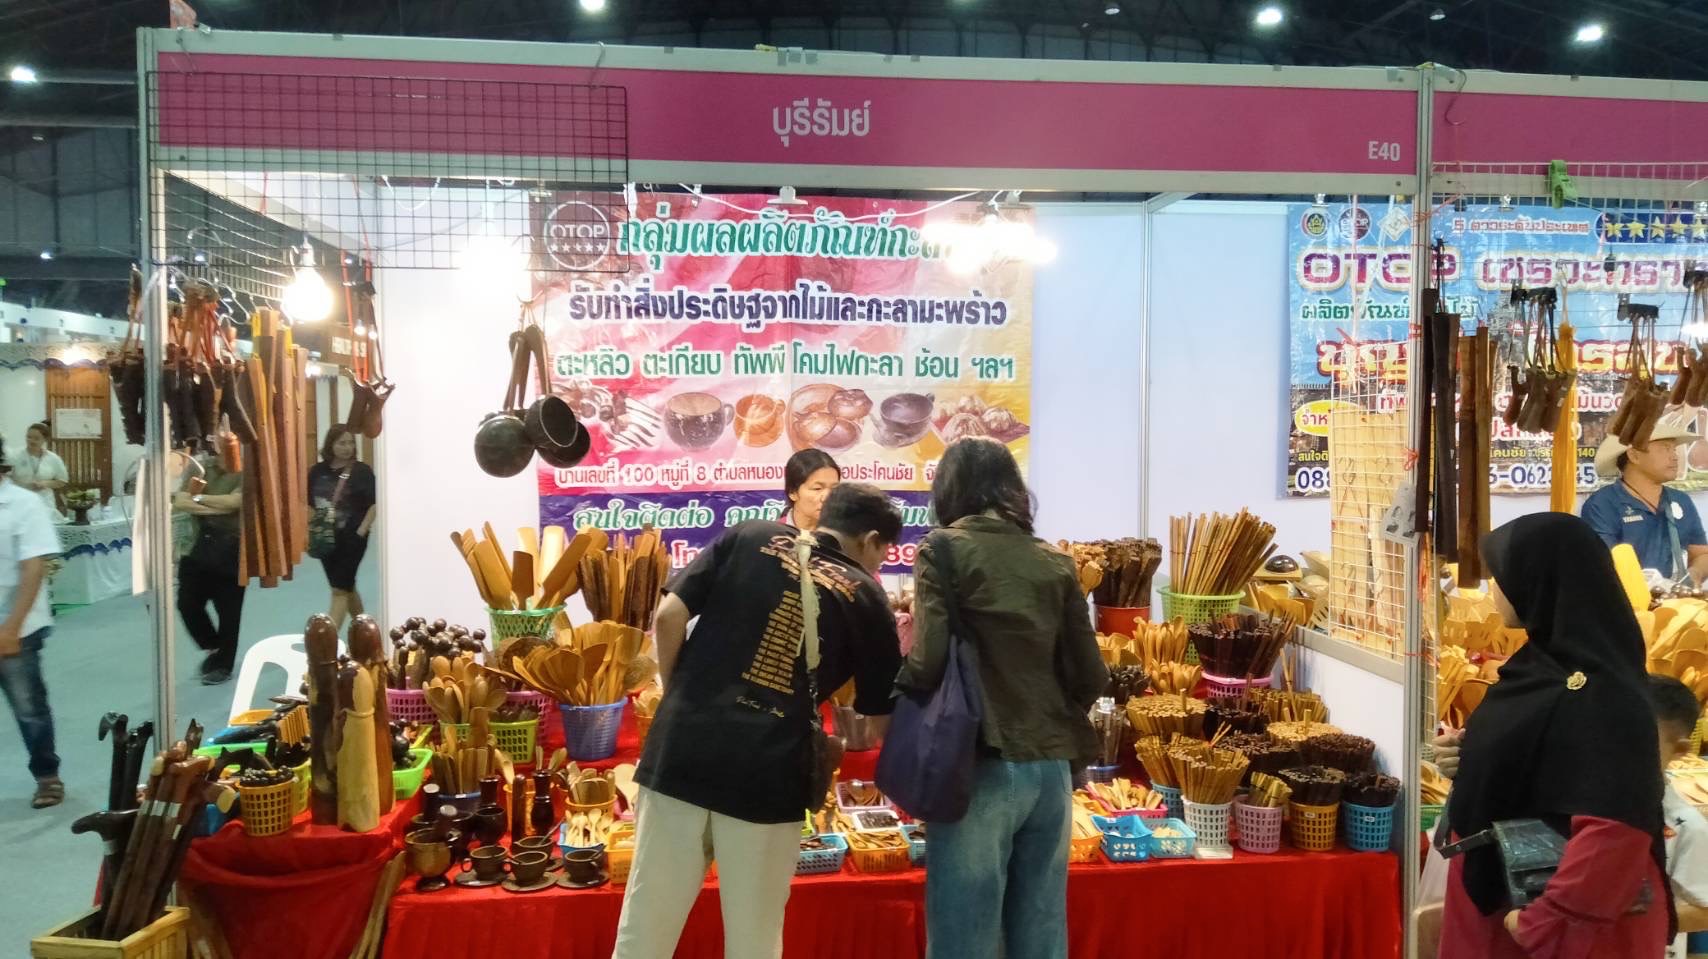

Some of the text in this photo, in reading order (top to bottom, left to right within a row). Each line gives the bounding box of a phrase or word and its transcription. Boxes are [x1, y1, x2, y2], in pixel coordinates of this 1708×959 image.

[773, 97, 871, 147] บุรีรัมย์
[1368, 141, 1401, 161] E40
[550, 224, 605, 239] OTOP
[557, 342, 1013, 379] ตะหลิว ตะเกียบ ทัพพี โคมไฟกะลา ช้อน ฯลฯ
[697, 466, 706, 481] 8
[714, 462, 787, 481] ตำบลหนอง
